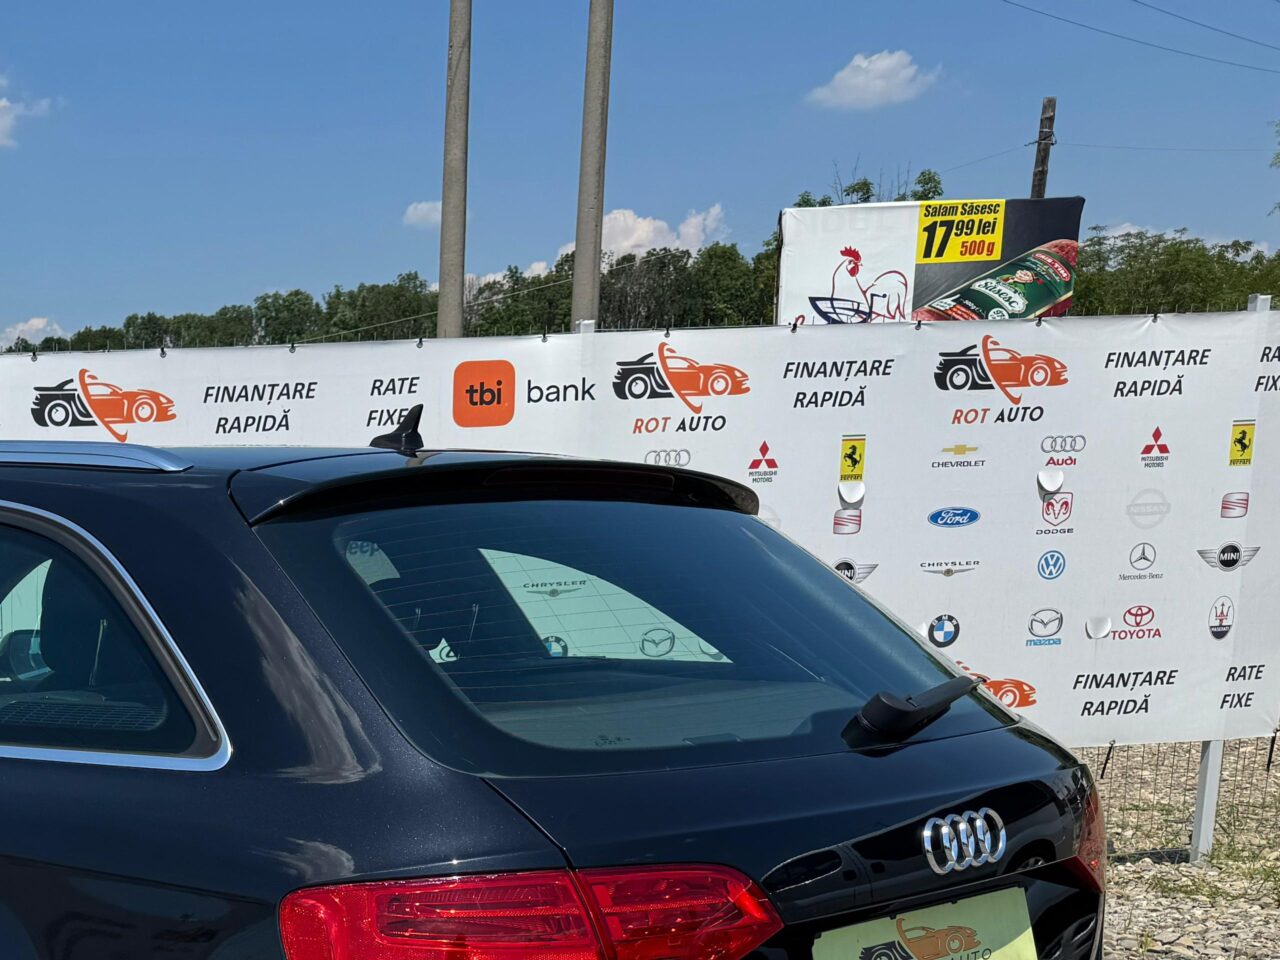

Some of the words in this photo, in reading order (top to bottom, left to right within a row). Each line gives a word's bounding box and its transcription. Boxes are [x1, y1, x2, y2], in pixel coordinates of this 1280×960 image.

[924, 204, 957, 217] Salam
[960, 202, 1000, 215] Săsesc
[922, 219, 955, 259] 17
[954, 218, 975, 237] 99
[976, 217, 998, 235] lei
[1104, 349, 1212, 370] FINANȚARE
[783, 359, 894, 381] FINANȚARE
[370, 376, 420, 397] RATE
[465, 380, 503, 406] tbi
[527, 377, 596, 404] bank
[1114, 374, 1184, 398] RAPIDĂ
[1255, 375, 1280, 392] FIX
[203, 382, 317, 405] FINANȚARE
[793, 385, 867, 409] RAPIDĂ
[215, 409, 290, 434] RAPIDĂ
[633, 416, 671, 434] ROT
[675, 415, 726, 432] AUTO
[951, 408, 990, 425] ROT
[994, 406, 1044, 423] AUTO
[932, 460, 986, 468] CHEVROLET
[1045, 456, 1076, 466] Audi
[937, 509, 971, 525] Ford
[1035, 528, 1075, 536] DODGE
[920, 560, 980, 568] CHRYSLER
[1219, 552, 1240, 562] MINI
[523, 580, 587, 588] CHRYSLER
[1025, 638, 1062, 646] mazda
[1111, 628, 1162, 641] TOYOTA
[1073, 669, 1178, 691] FINANȚARE
[1225, 664, 1265, 682] RATE
[1081, 694, 1151, 716] RAPIDĂ
[1220, 692, 1254, 709] FIXE
